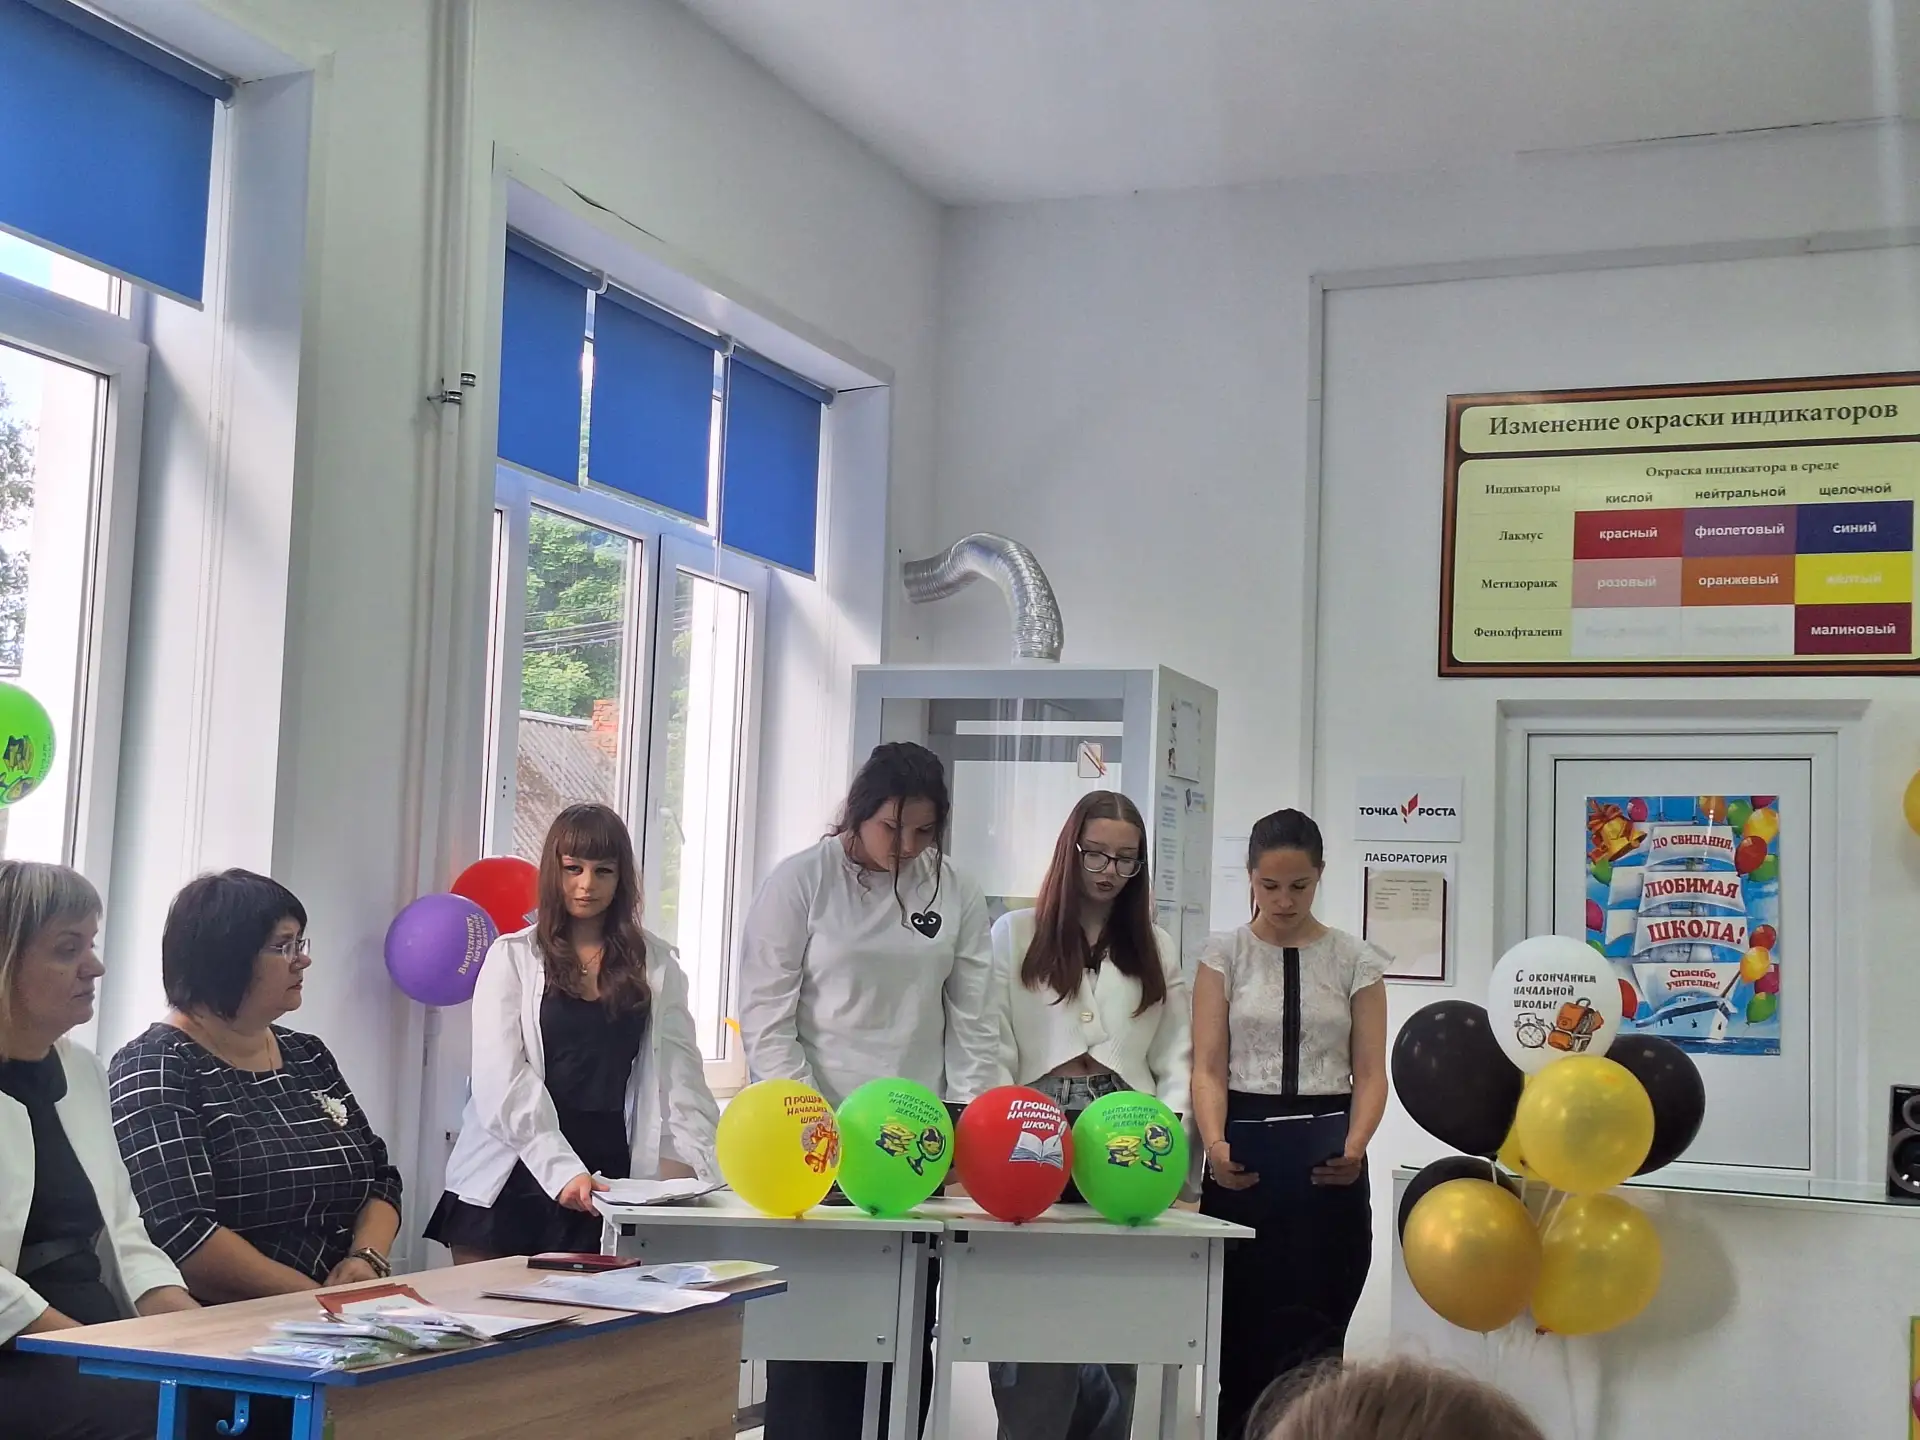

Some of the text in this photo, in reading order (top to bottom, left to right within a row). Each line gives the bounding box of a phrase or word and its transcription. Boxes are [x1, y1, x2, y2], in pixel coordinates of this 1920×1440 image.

[1489, 402, 1899, 436] Изменение окраски индикаторов
[1646, 460, 1840, 478] Окраска индикатора в среде
[1485, 484, 1561, 495] Индикаторы
[1605, 482, 1892, 504] кислой нейтральной щелочной
[1499, 520, 1877, 543] Лакмус красный фиолетовый синий
[1481, 578, 1558, 591] Метилоранж
[1597, 575, 1657, 589] розовый
[1698, 573, 1779, 588] оранжевый
[1474, 621, 1896, 640] Фенолфталеин малиновый
[1359, 806, 1456, 817] ТОЧКА РОСТА
[1652, 834, 1734, 852] ДО СВИДАНИЯ,
[1364, 853, 1448, 864] ЛАБОРАТОРИЯ
[1644, 877, 1740, 899] ЛЮБИМАЯ
[1647, 919, 1745, 945] ШКОЛА!
[1515, 969, 1525, 983] С
[1669, 968, 1717, 979] Спасибо
[1513, 985, 1574, 997] НАЧАЛЬНОЙ
[1666, 978, 1721, 990] учителям!
[1513, 1000, 1557, 1010] ШКОЛЫ!
